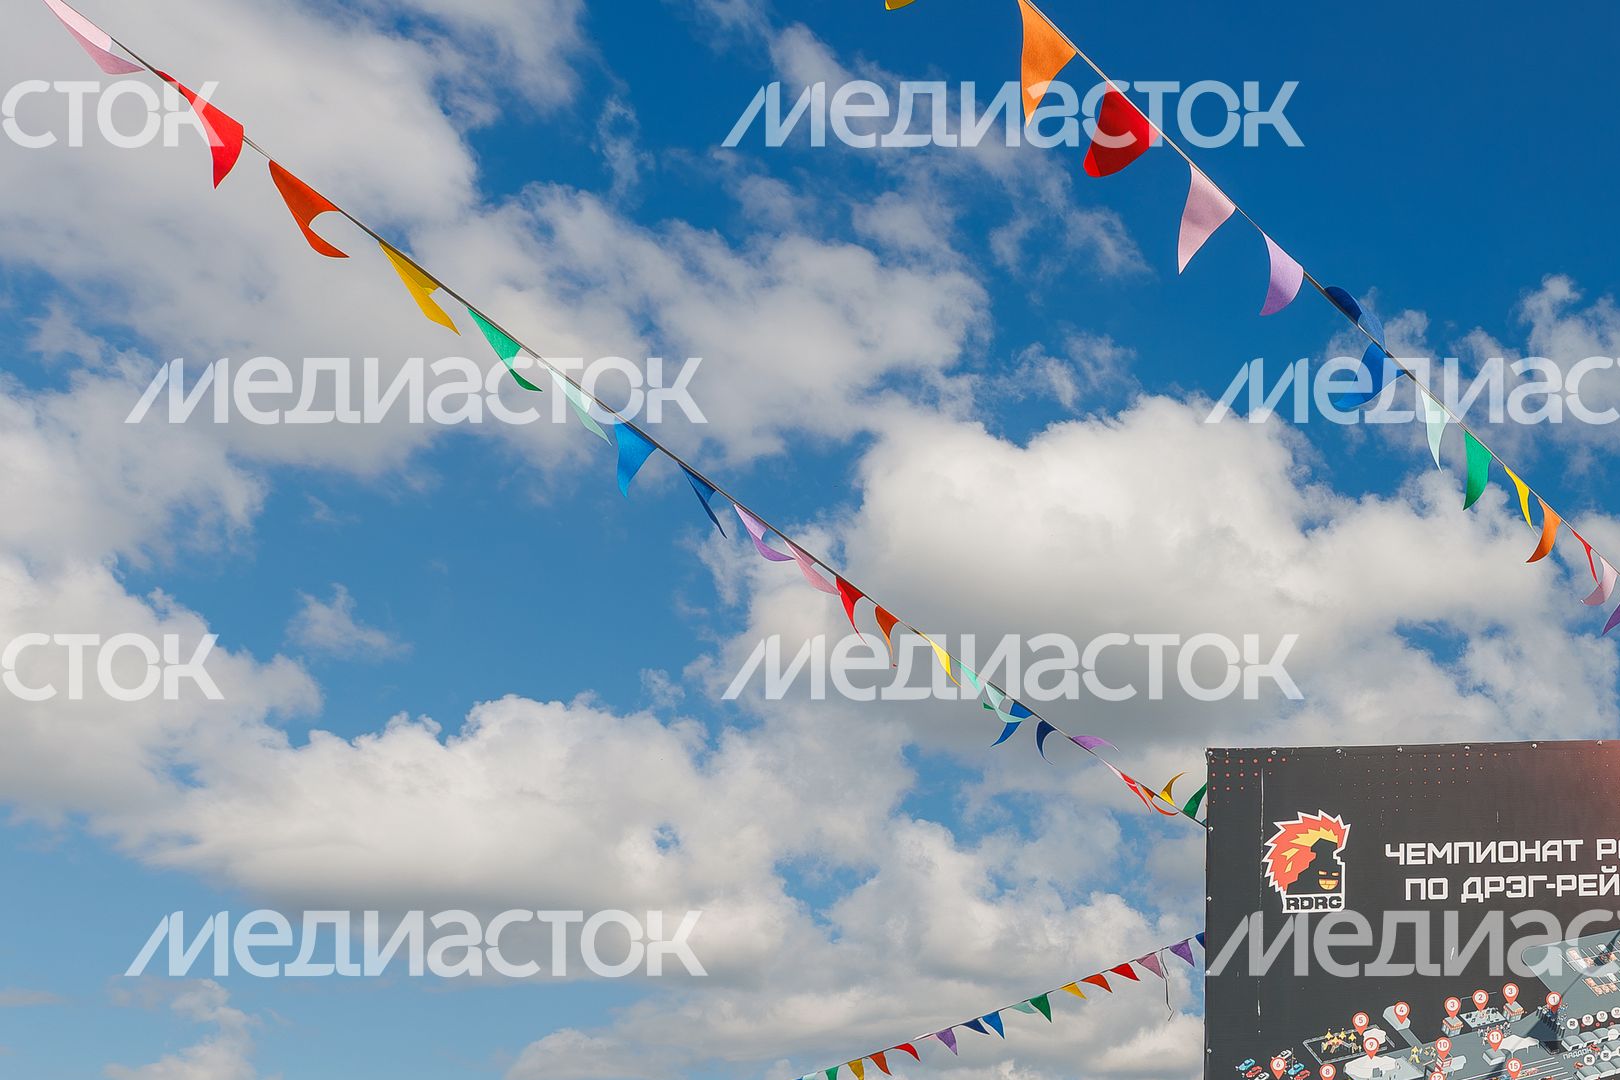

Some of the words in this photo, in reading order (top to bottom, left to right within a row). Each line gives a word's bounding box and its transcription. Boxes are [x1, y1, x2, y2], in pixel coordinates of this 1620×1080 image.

[1385, 839, 1583, 866] ЧЕМПИОНАТ
[1405, 877, 1449, 901] ПО
[1286, 896, 1342, 911] RDRC
